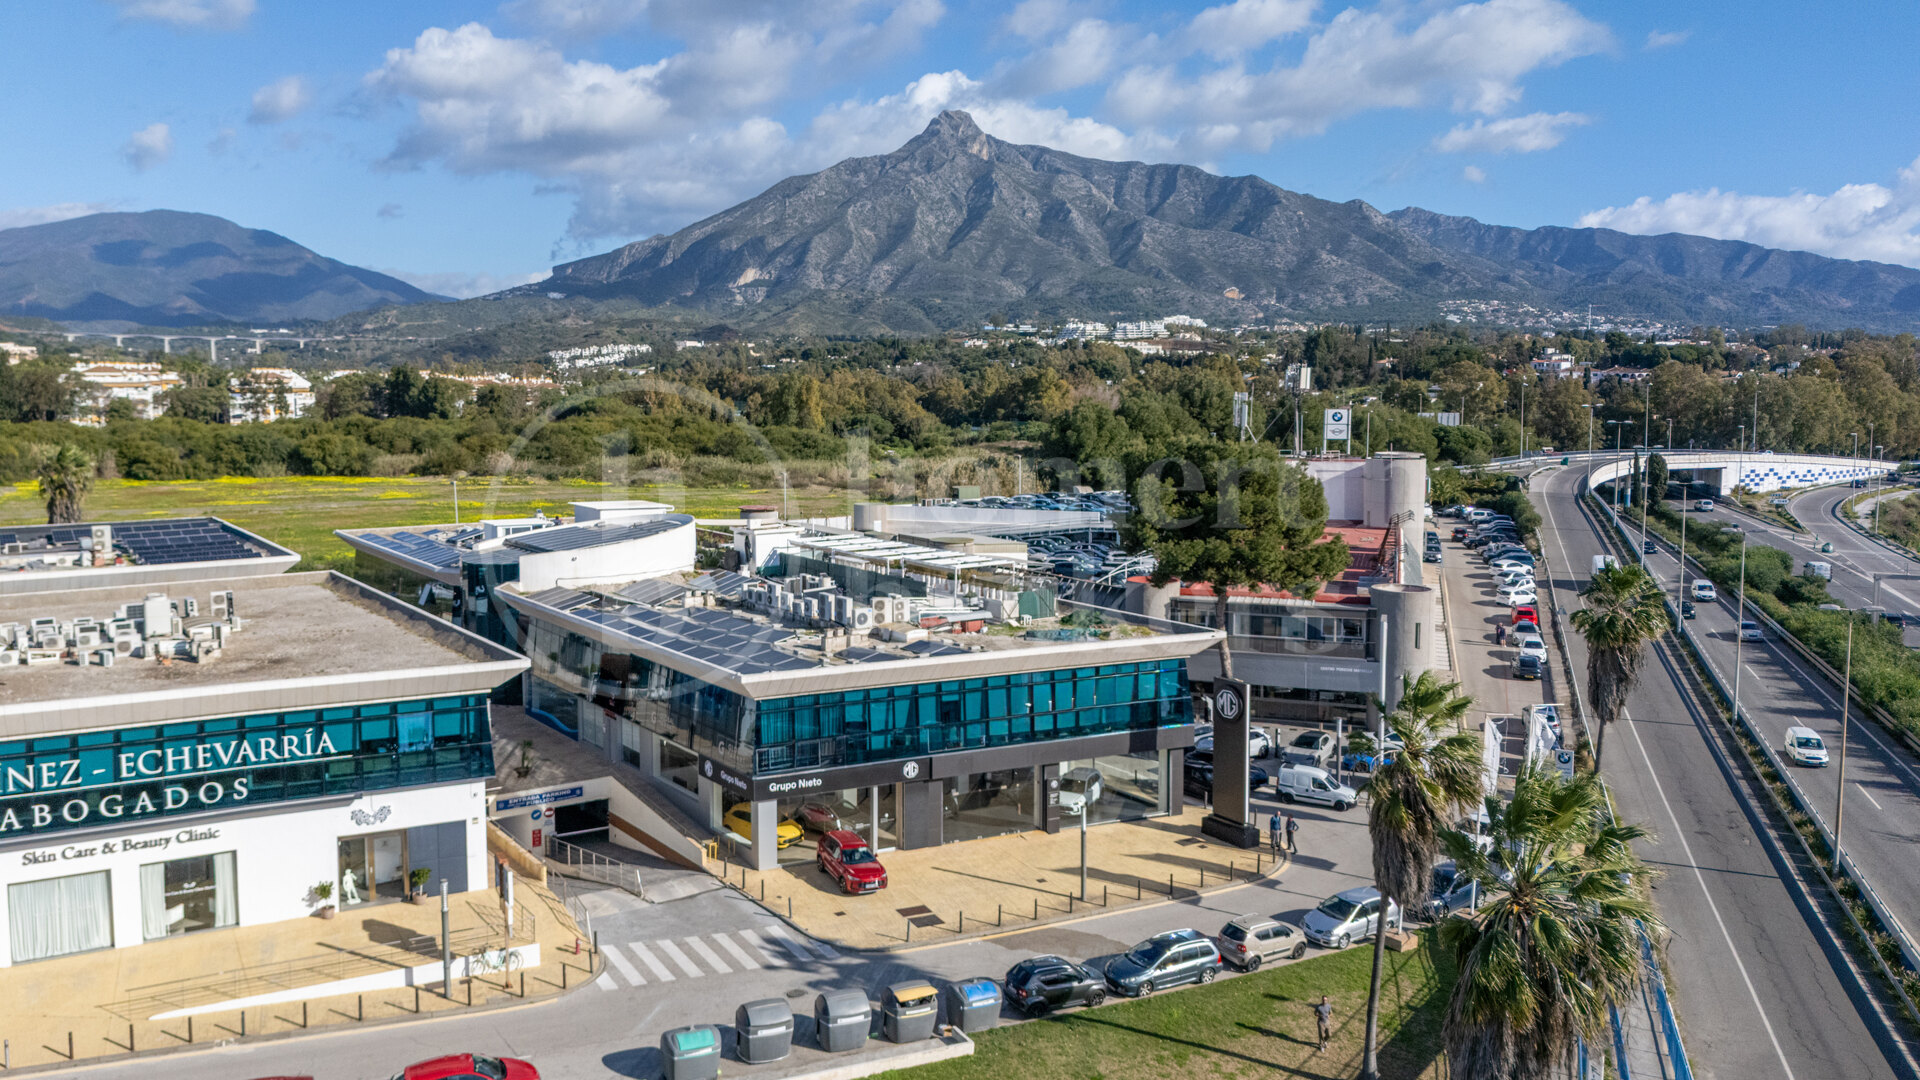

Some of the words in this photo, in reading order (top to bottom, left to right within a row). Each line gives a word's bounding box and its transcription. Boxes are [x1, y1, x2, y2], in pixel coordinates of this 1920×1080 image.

[1217, 690, 1238, 718] MG
[0, 759, 82, 793] NEZ
[119, 728, 338, 778] ECHEVARRÍA
[769, 781, 797, 792] Grupo
[798, 778, 823, 789] Nieto
[0, 777, 249, 832] ABOGADOS
[22, 851, 57, 866] Skin
[61, 846, 98, 859] Care
[102, 842, 117, 855] &
[121, 835, 173, 852] Beauty
[176, 828, 221, 844] Clinic
